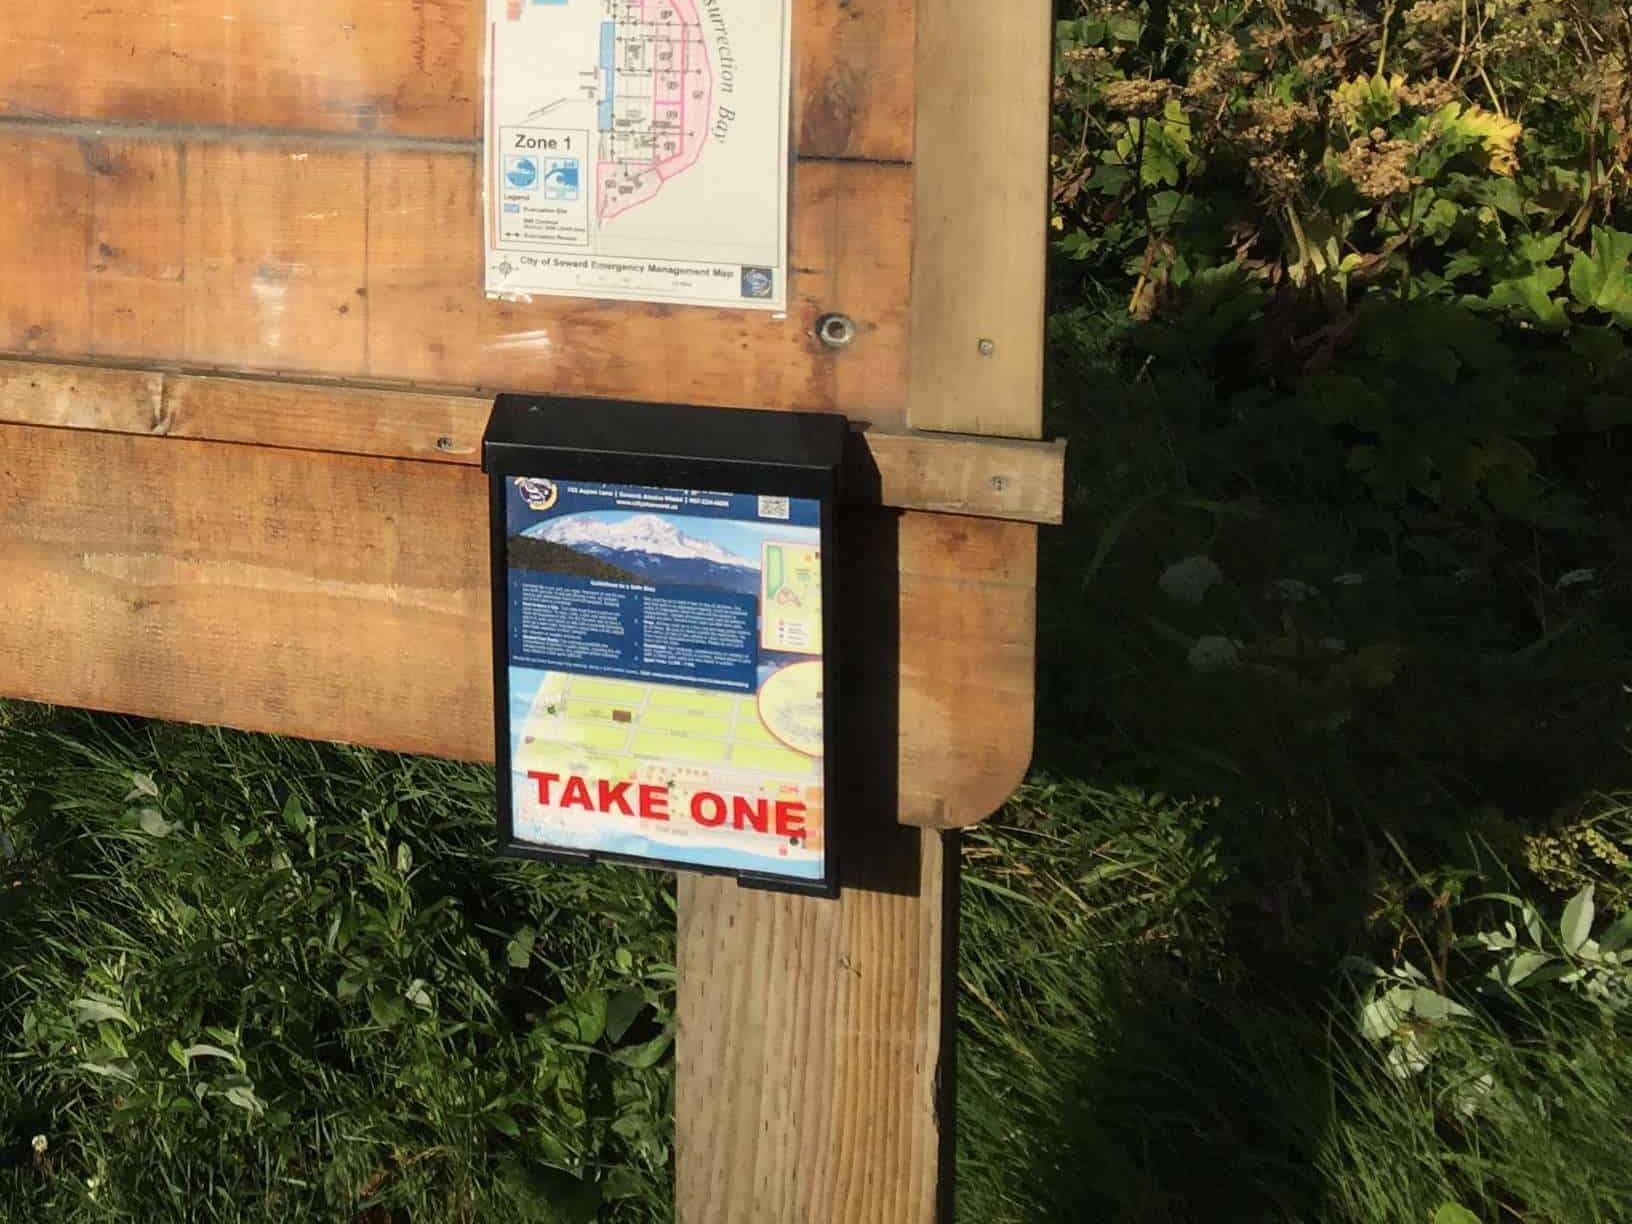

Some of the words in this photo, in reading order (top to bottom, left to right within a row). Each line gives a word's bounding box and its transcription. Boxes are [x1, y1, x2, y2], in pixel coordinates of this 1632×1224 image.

[514, 133, 557, 149] Zone
[563, 136, 572, 150] 1
[519, 255, 538, 267] City
[540, 257, 551, 265] of
[553, 257, 589, 269] Seward
[590, 260, 645, 273] Emergency
[647, 262, 712, 277] Management
[713, 268, 735, 279] Map
[527, 770, 671, 822] TAKE
[690, 790, 807, 840] ONE
